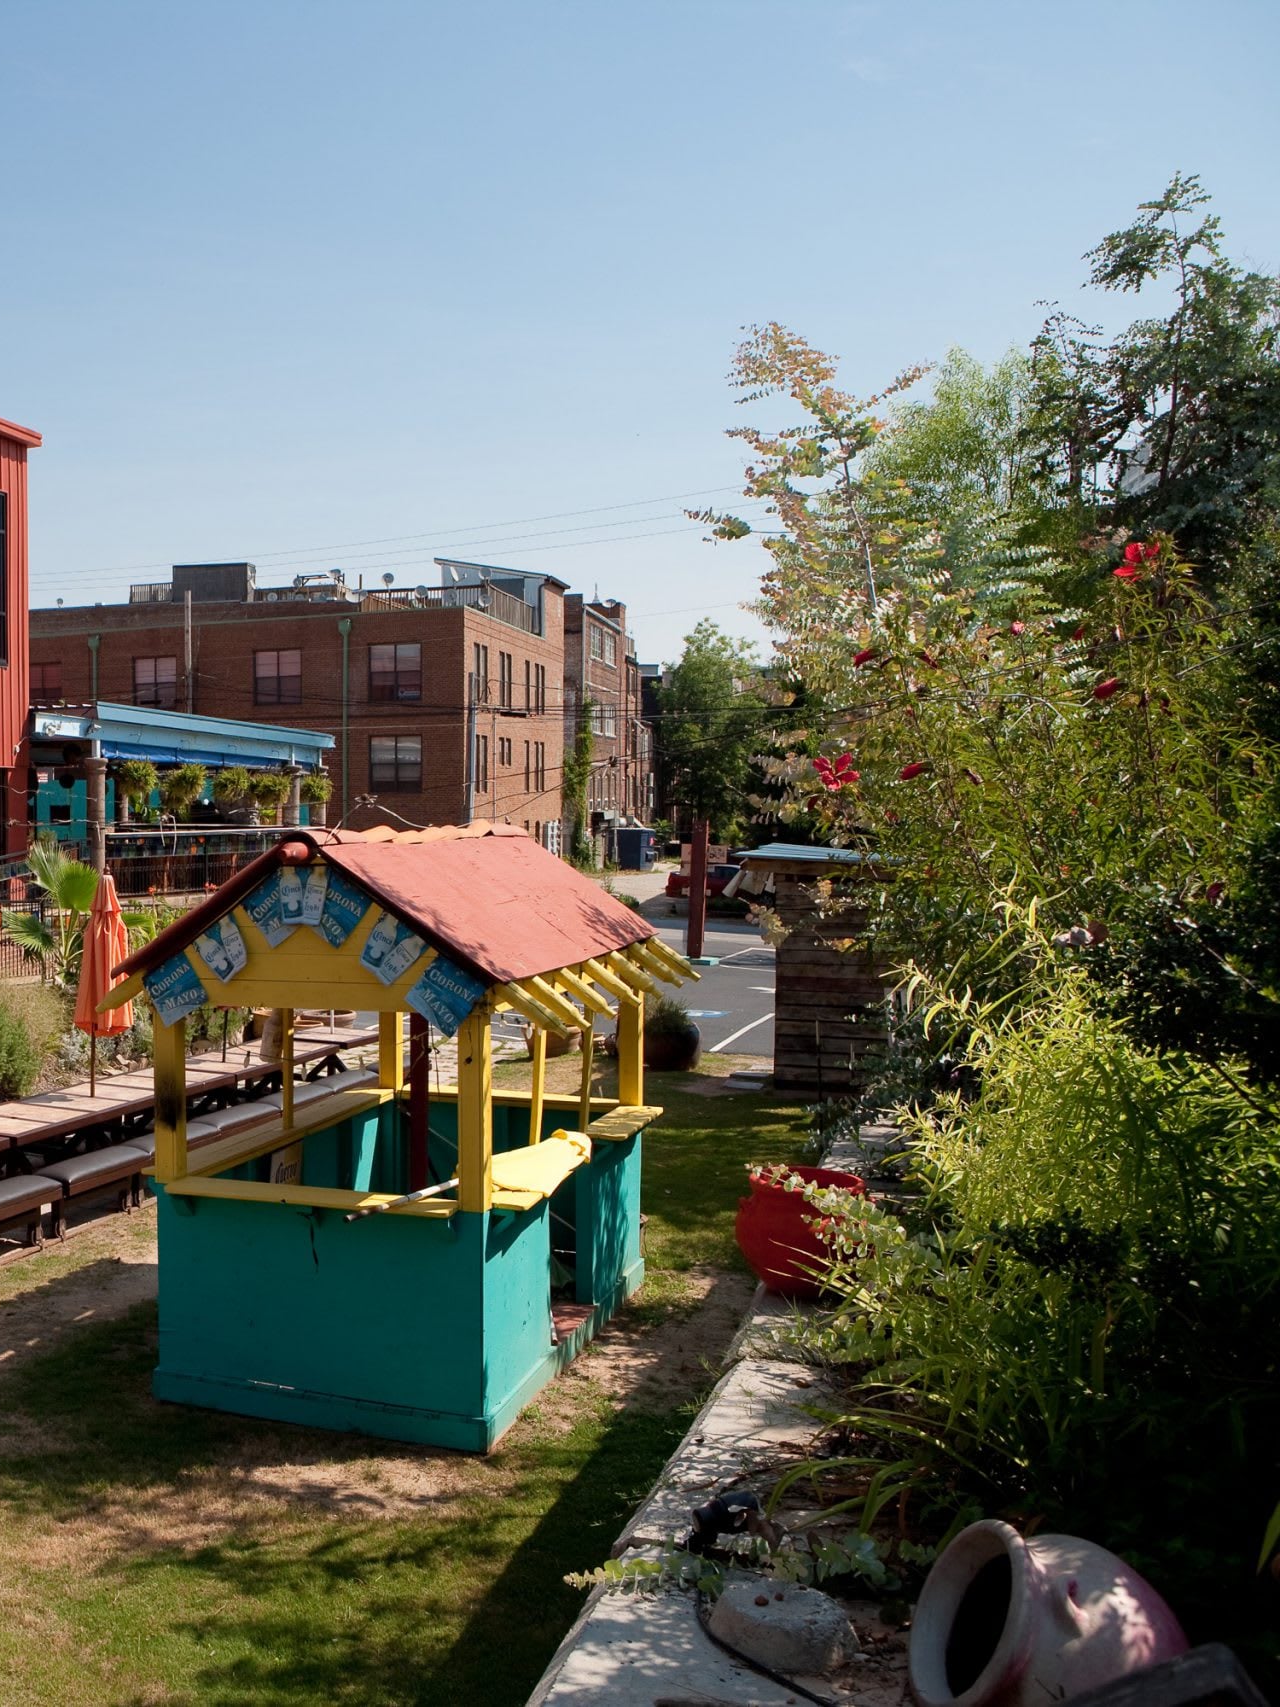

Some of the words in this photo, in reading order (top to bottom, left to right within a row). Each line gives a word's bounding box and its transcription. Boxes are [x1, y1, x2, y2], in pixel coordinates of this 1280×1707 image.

[253, 887, 280, 920] CORO
[326, 888, 362, 917] ORONA
[151, 963, 190, 996] CORONA
[165, 989, 198, 1011] MAYO
[422, 989, 455, 1024] MAYO
